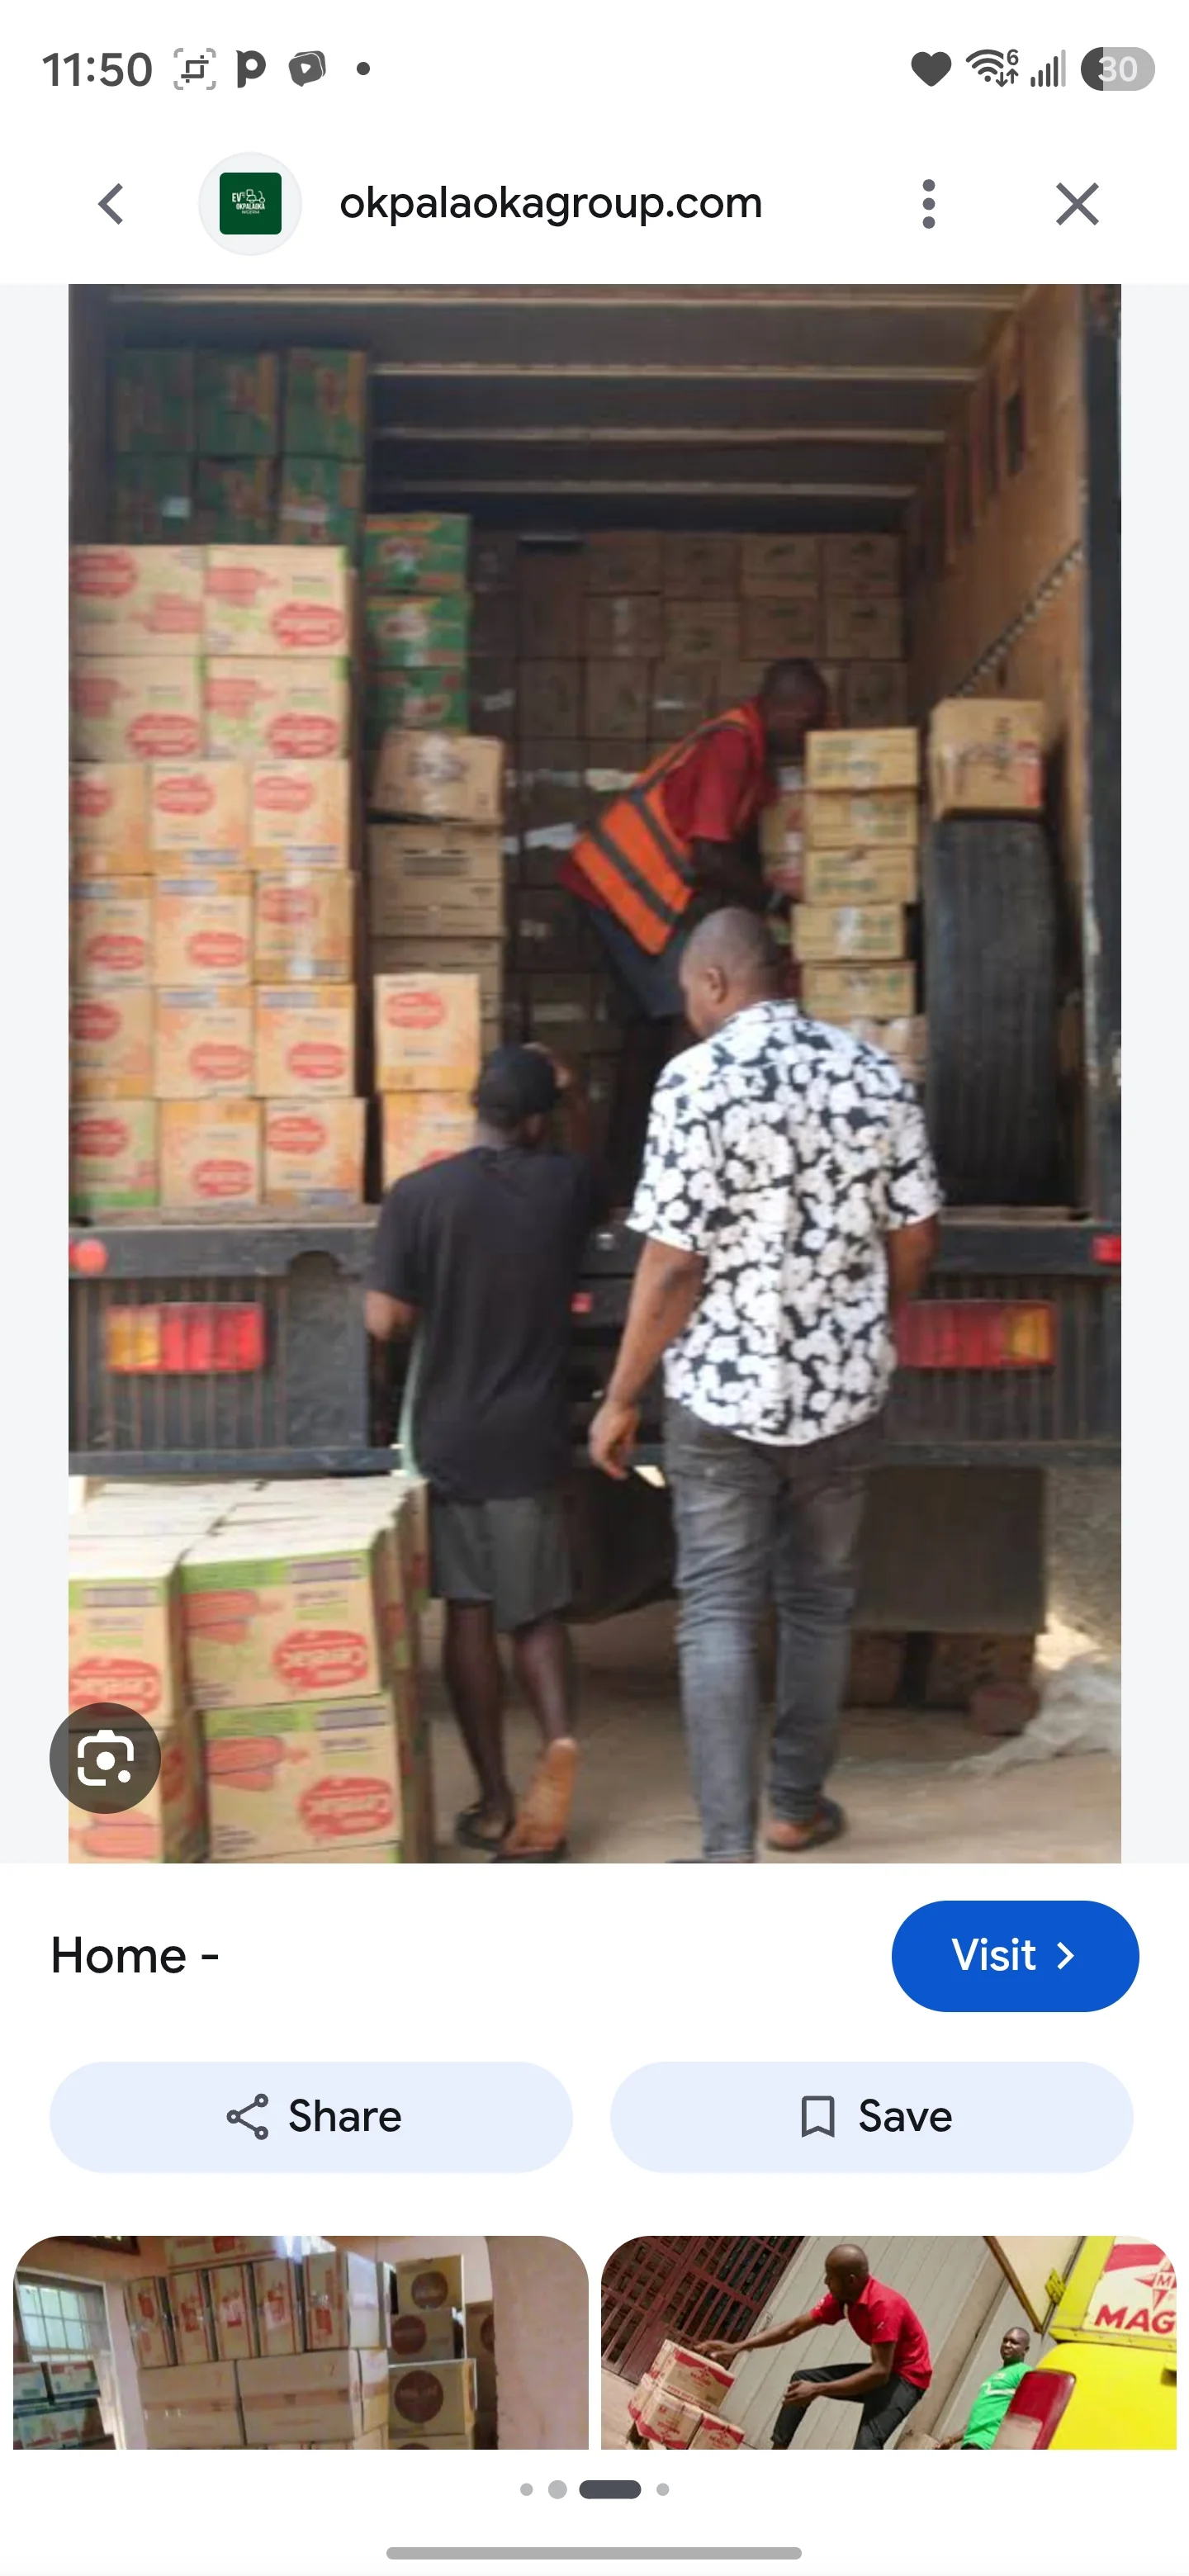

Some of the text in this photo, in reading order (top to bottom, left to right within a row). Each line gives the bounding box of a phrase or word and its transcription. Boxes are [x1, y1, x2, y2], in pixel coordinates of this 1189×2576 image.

[42, 52, 152, 88] 11:50
[1097, 55, 1138, 83] 30
[235, 202, 266, 211] OKPALAOKA
[340, 186, 762, 227] okpalaokagroup.com
[53, 1936, 187, 1974] Home
[951, 1937, 1037, 1972] Visit
[289, 2098, 402, 2133] Share
[859, 2098, 953, 2133] Save
[1094, 2304, 1177, 2335] MAG
